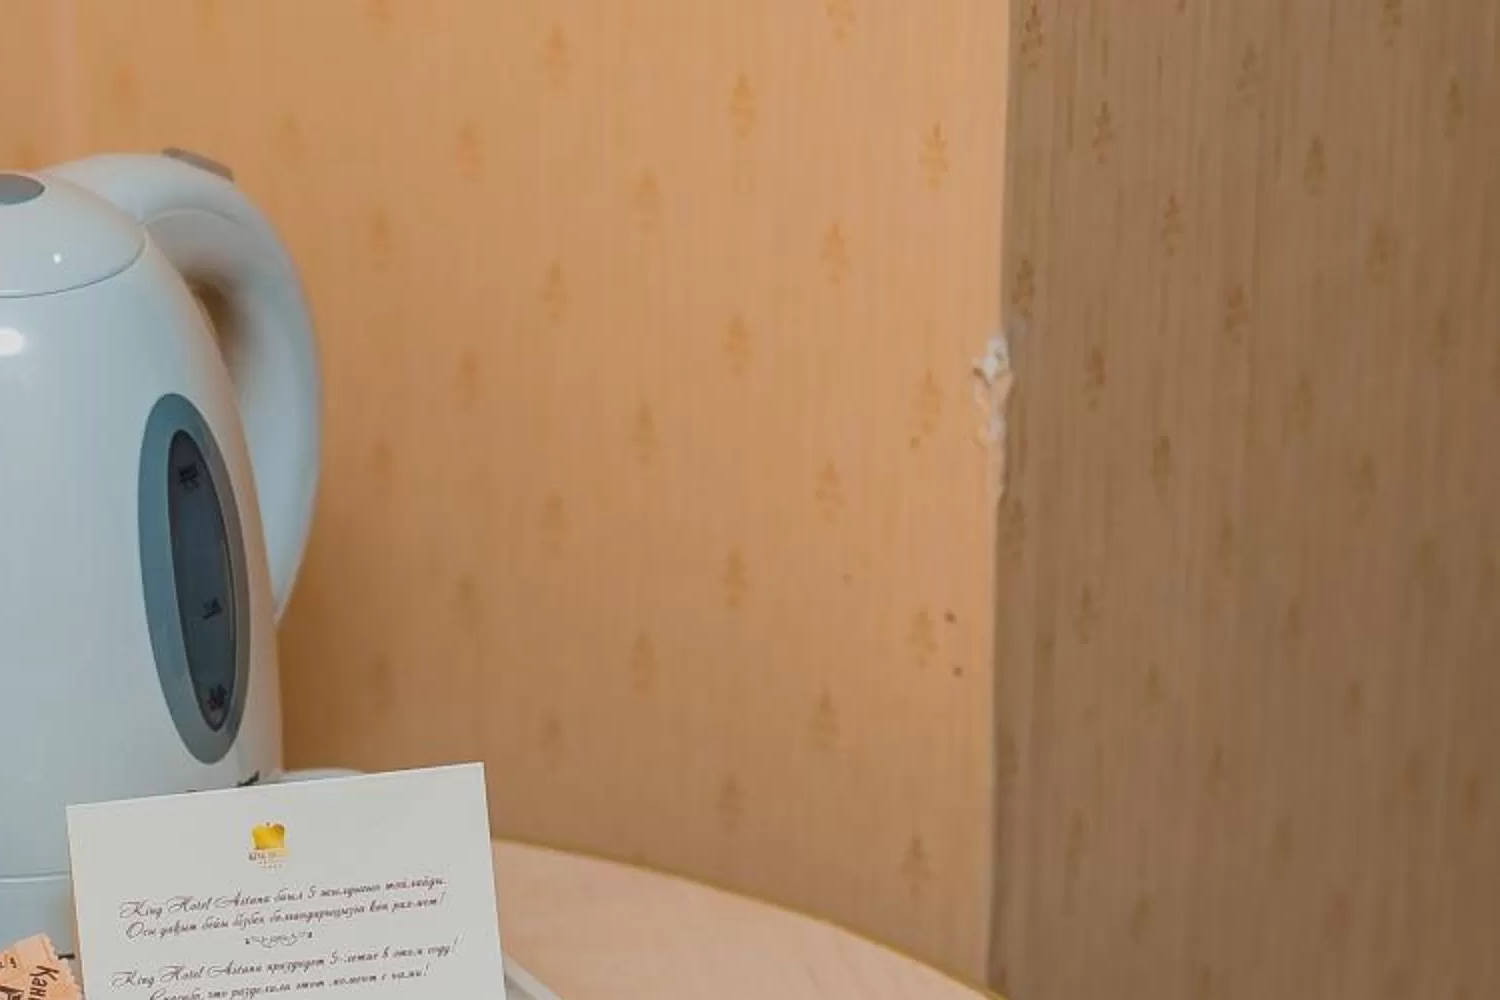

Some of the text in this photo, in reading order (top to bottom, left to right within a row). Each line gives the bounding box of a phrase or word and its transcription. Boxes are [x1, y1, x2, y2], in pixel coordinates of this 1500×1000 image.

[120, 899, 163, 919] King
[167, 896, 212, 913] Hotel
[214, 888, 270, 908] Astana
[308, 885, 316, 899] 5
[111, 970, 155, 988] King
[160, 965, 204, 982] Hotel
[208, 960, 262, 977] Astana
